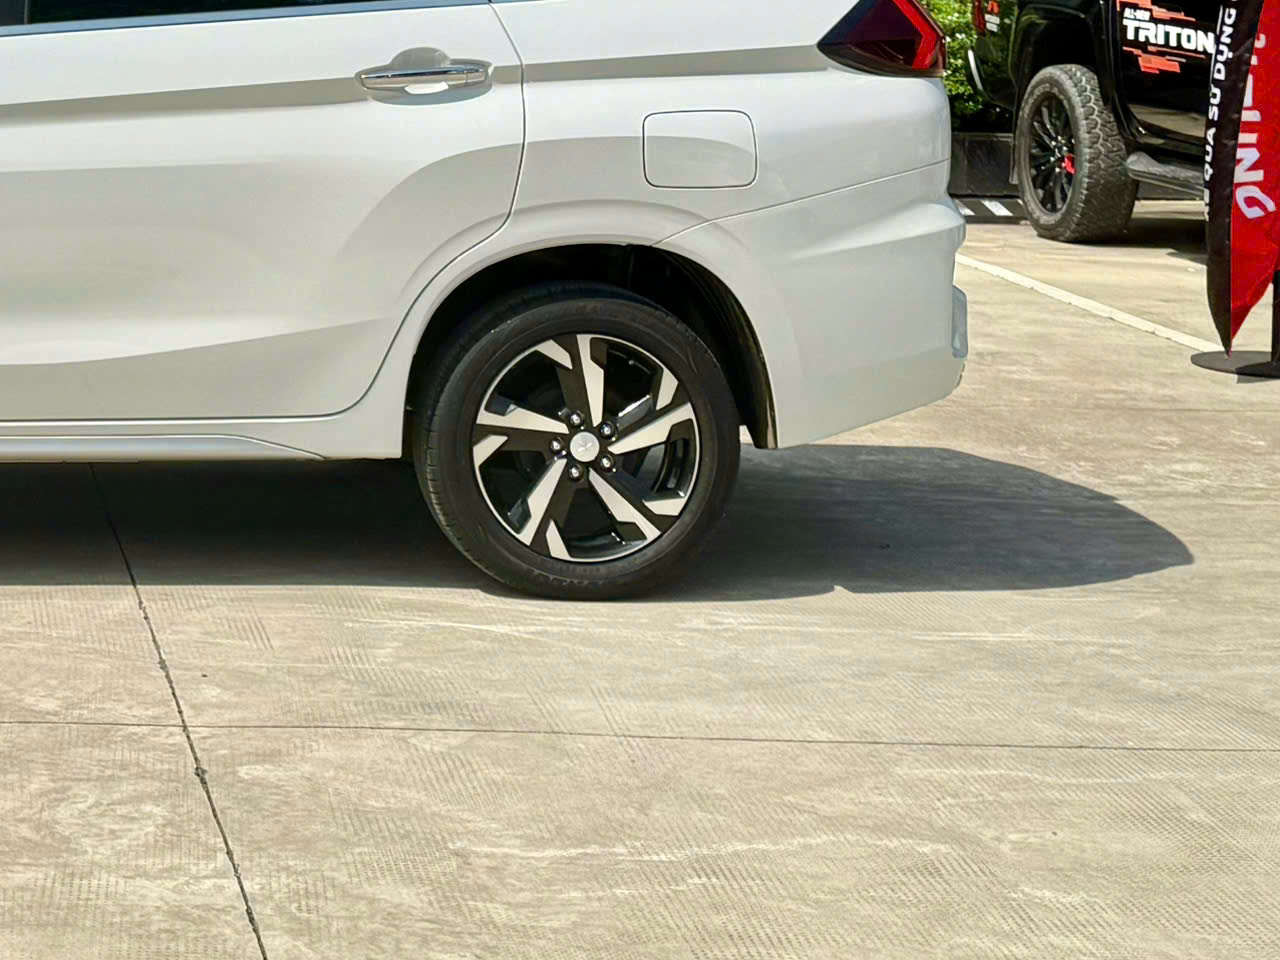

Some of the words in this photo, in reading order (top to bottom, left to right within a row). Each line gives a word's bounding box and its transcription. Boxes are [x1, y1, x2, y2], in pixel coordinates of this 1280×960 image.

[1122, 18, 1216, 54] TRITON
[1203, 126, 1217, 182] QUA
[1213, 7, 1237, 81] DỤNG
